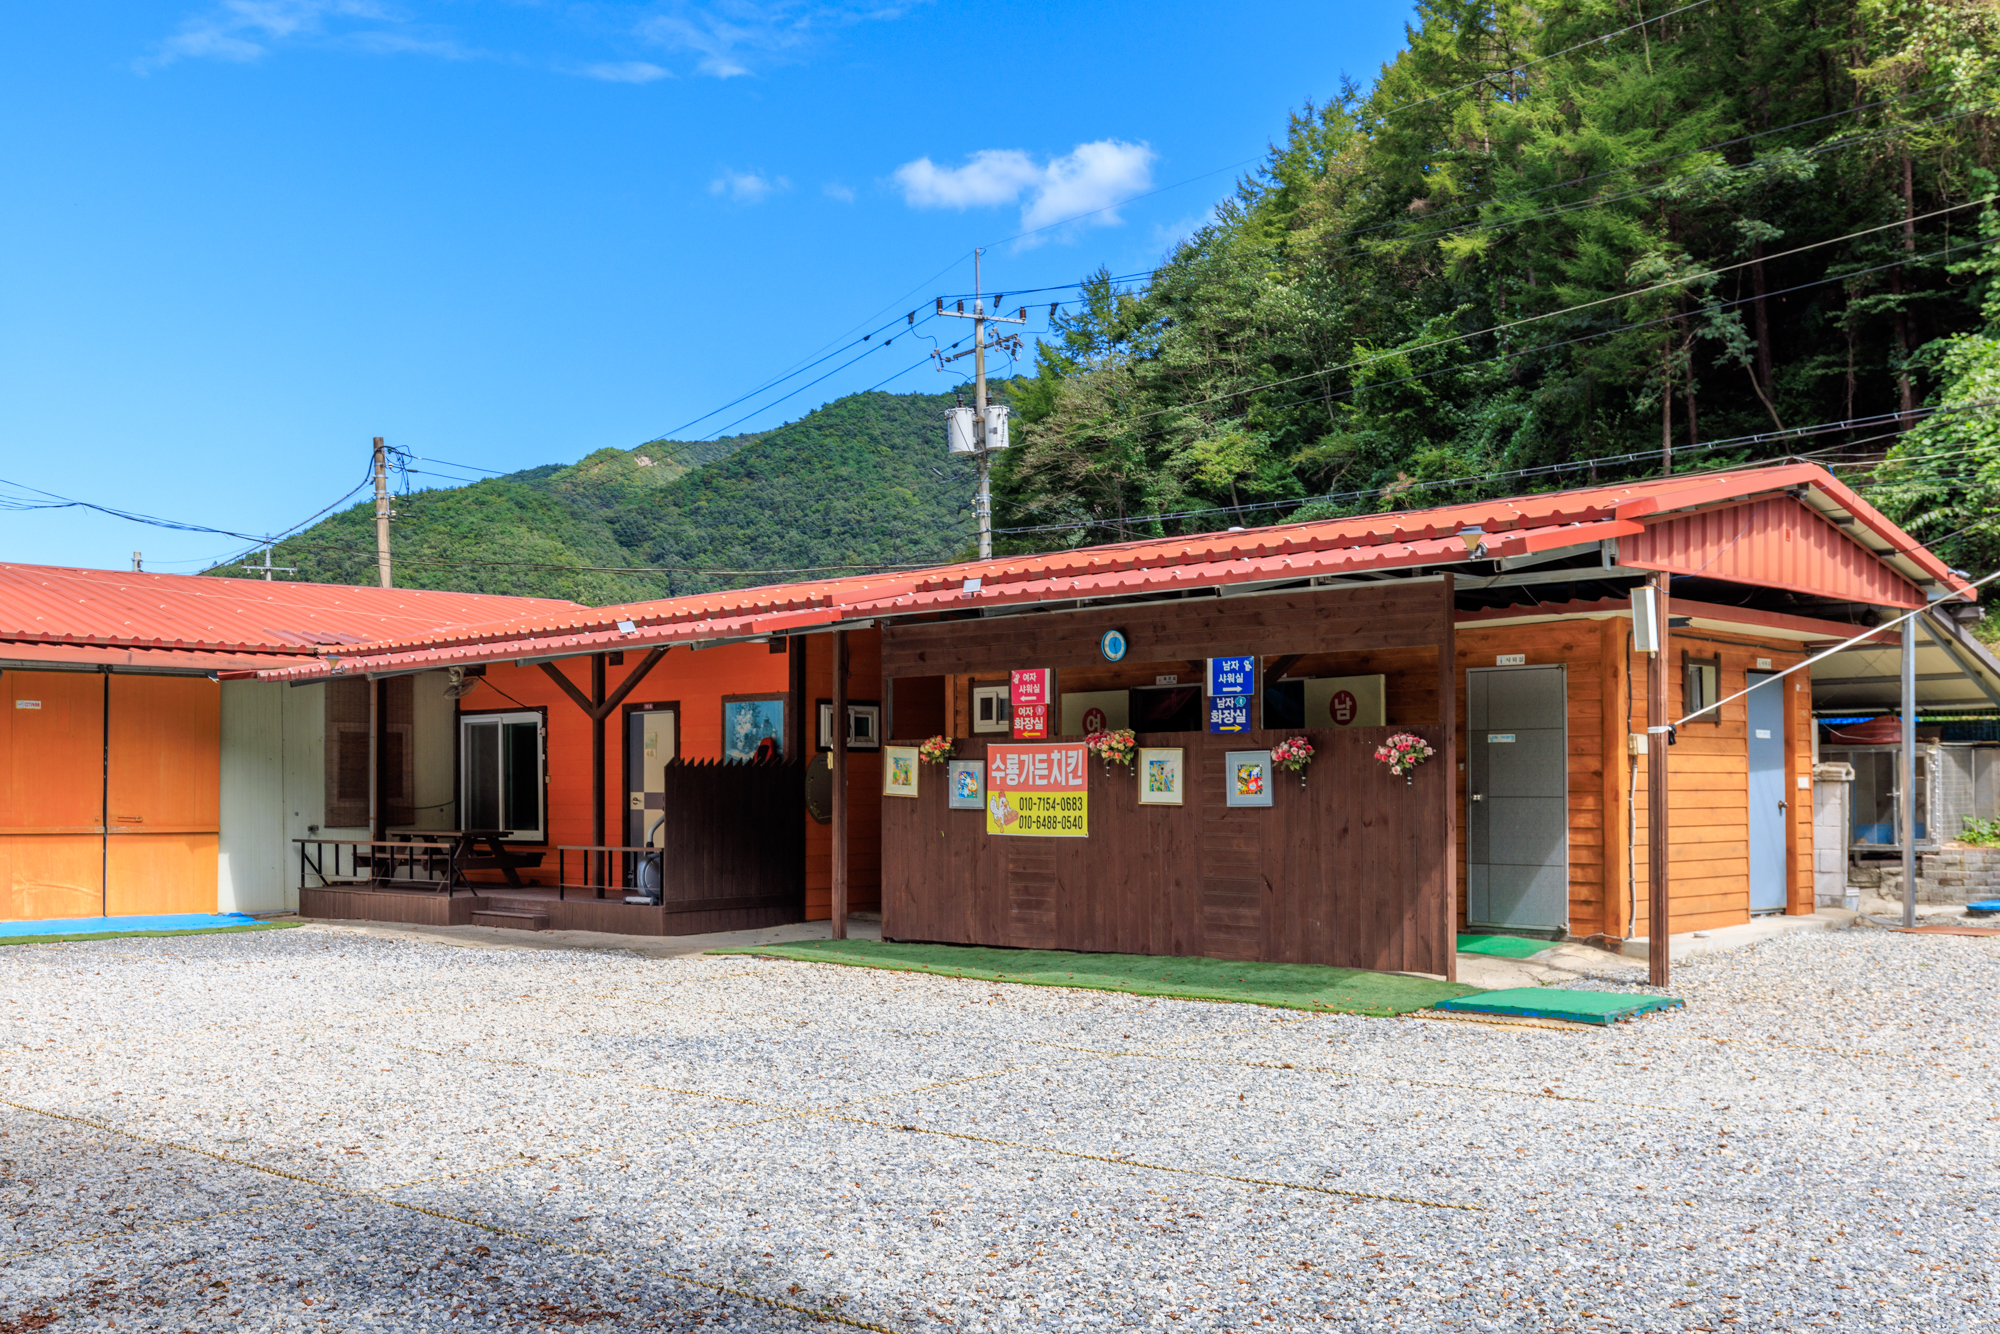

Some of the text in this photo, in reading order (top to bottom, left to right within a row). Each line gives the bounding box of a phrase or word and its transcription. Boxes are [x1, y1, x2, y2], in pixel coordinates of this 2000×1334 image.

[1222, 660, 1240, 671] 남자
[1022, 672, 1037, 682] 여자
[1218, 672, 1243, 684] 샤워실
[1019, 684, 1040, 694] 샤워실
[1216, 697, 1234, 709] 남자
[1334, 697, 1352, 720] 남
[1018, 707, 1033, 716] 여자
[1210, 709, 1246, 724] 화장실
[1014, 717, 1044, 730] 화장실
[1086, 713, 1101, 733] 여
[1019, 797, 1083, 811] 010-7154-0683
[1019, 815, 1083, 830] 010-6488-0540
